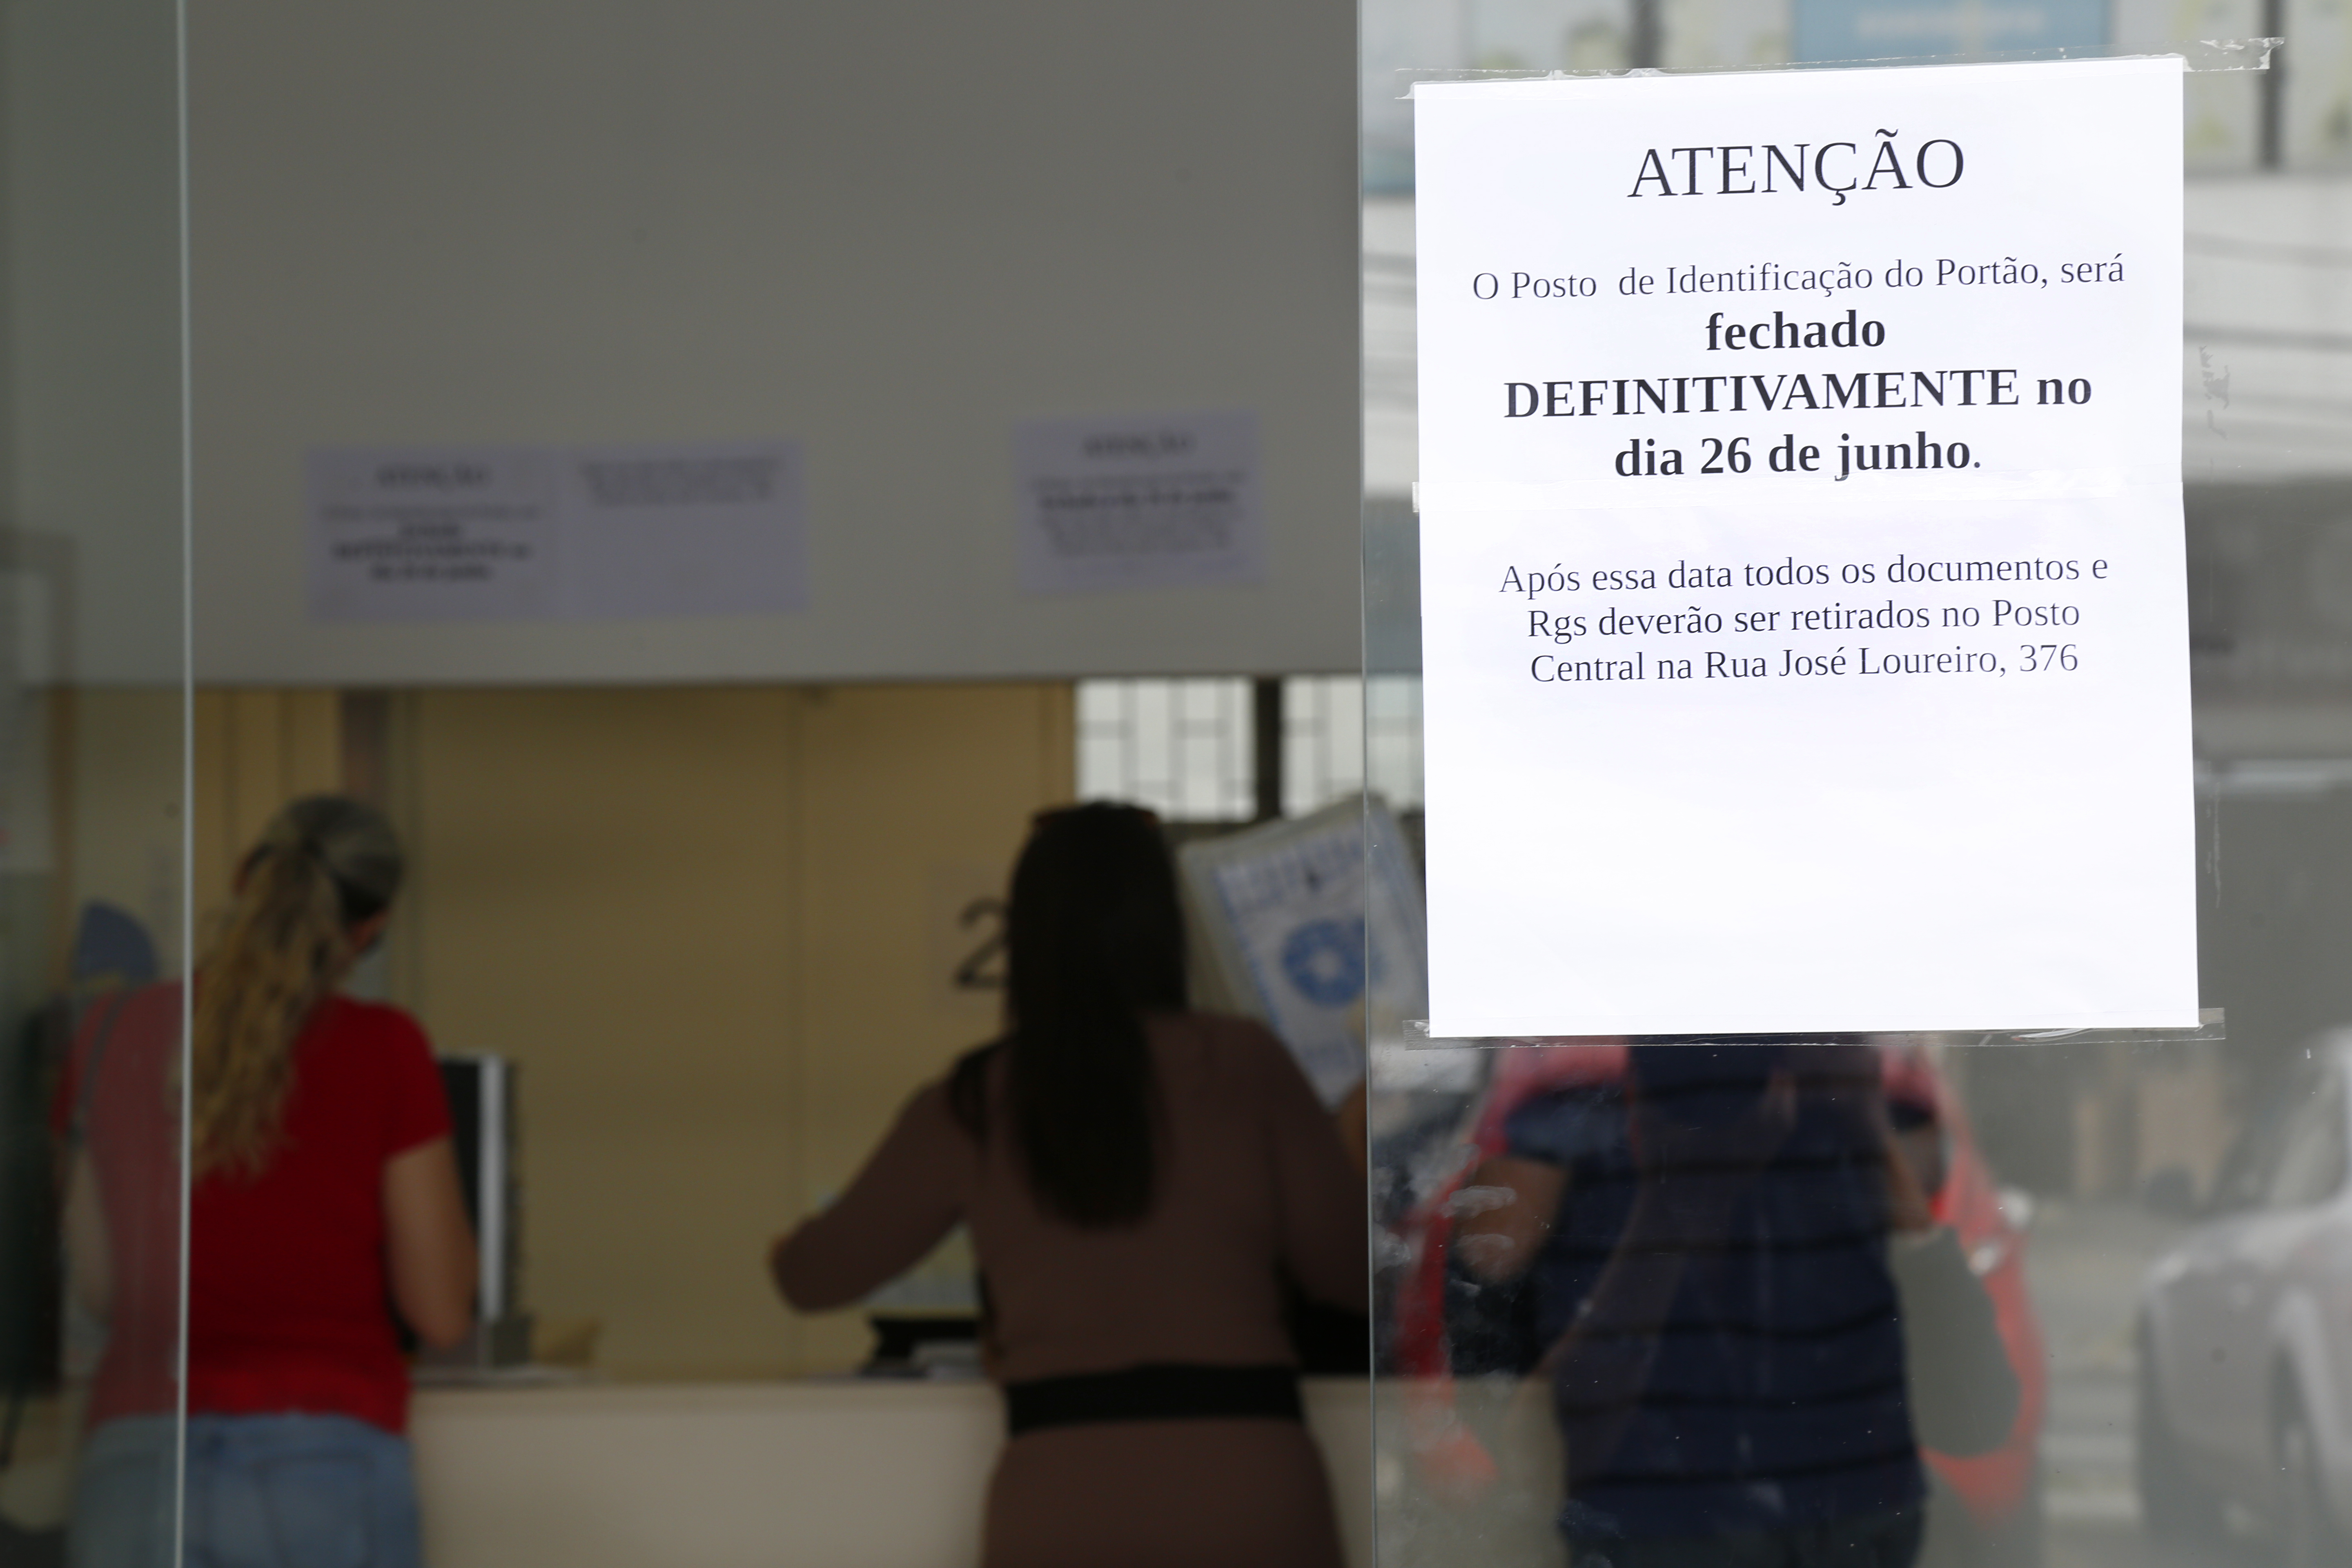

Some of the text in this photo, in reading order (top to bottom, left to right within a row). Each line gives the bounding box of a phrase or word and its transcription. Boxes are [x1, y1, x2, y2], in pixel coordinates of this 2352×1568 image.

[1626, 128, 1964, 207] ATENÇÃO
[1473, 252, 2125, 300] O Posto de Identificação do Portão, será
[1705, 309, 1886, 351] fechado
[1503, 369, 2092, 418] DEFINITIVAMENTE no
[1615, 430, 1981, 482] dia 26 de junho.
[1499, 554, 2108, 601] Após essa data todos os documentos e
[1527, 599, 2080, 645] Rgs deverão ser retirados no Posto
[1531, 644, 2078, 682] Central na Rua José Loureiro, 376
